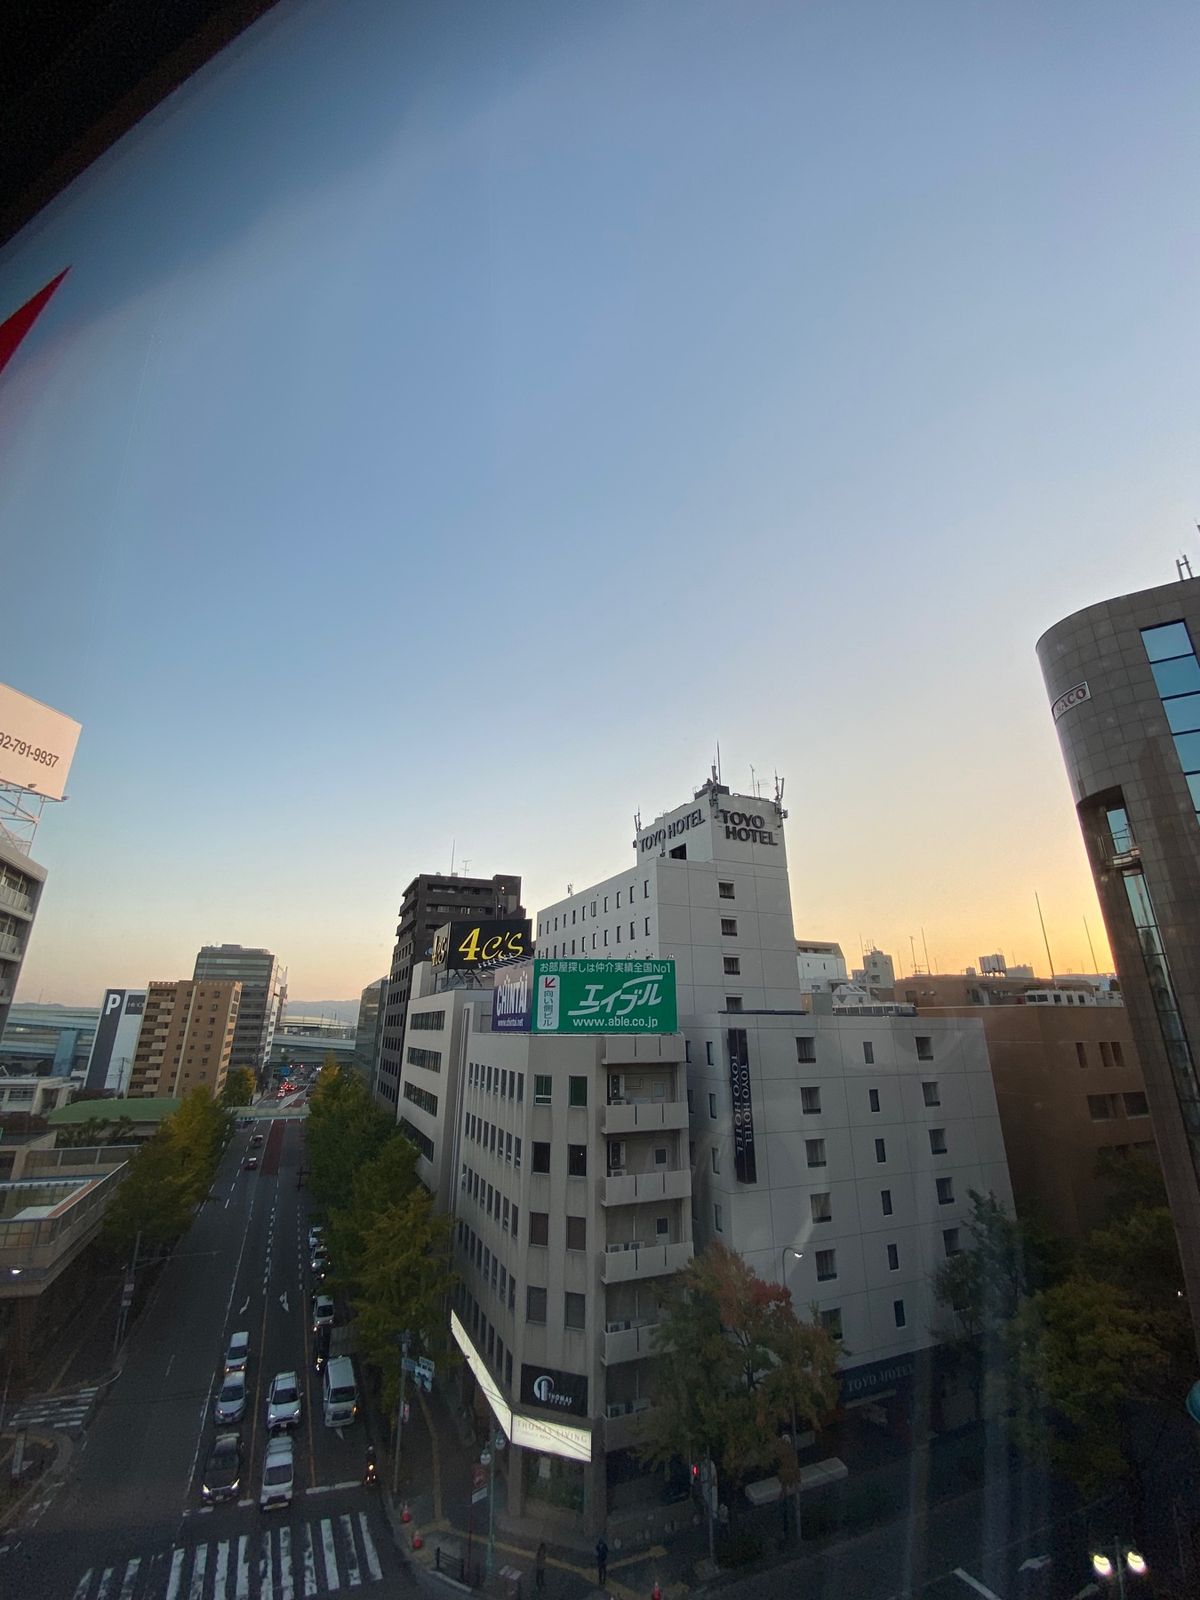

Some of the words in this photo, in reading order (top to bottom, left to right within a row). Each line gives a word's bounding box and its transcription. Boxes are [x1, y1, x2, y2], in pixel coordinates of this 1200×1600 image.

[638, 828, 667, 853] TOYO
[668, 808, 706, 839] HOTEL
[719, 808, 766, 829] TOYO
[725, 825, 779, 846] HOTEL
[105, 994, 121, 1015] P
[496, 974, 528, 1016] CHINTAI
[568, 975, 664, 1016] エイブル
[572, 1016, 659, 1027] www.able.co.jp
[731, 1055, 740, 1096] TOYO
[741, 1064, 749, 1098] TOYO
[734, 1102, 744, 1154] HOTEL
[744, 1102, 752, 1145] HOTEL
